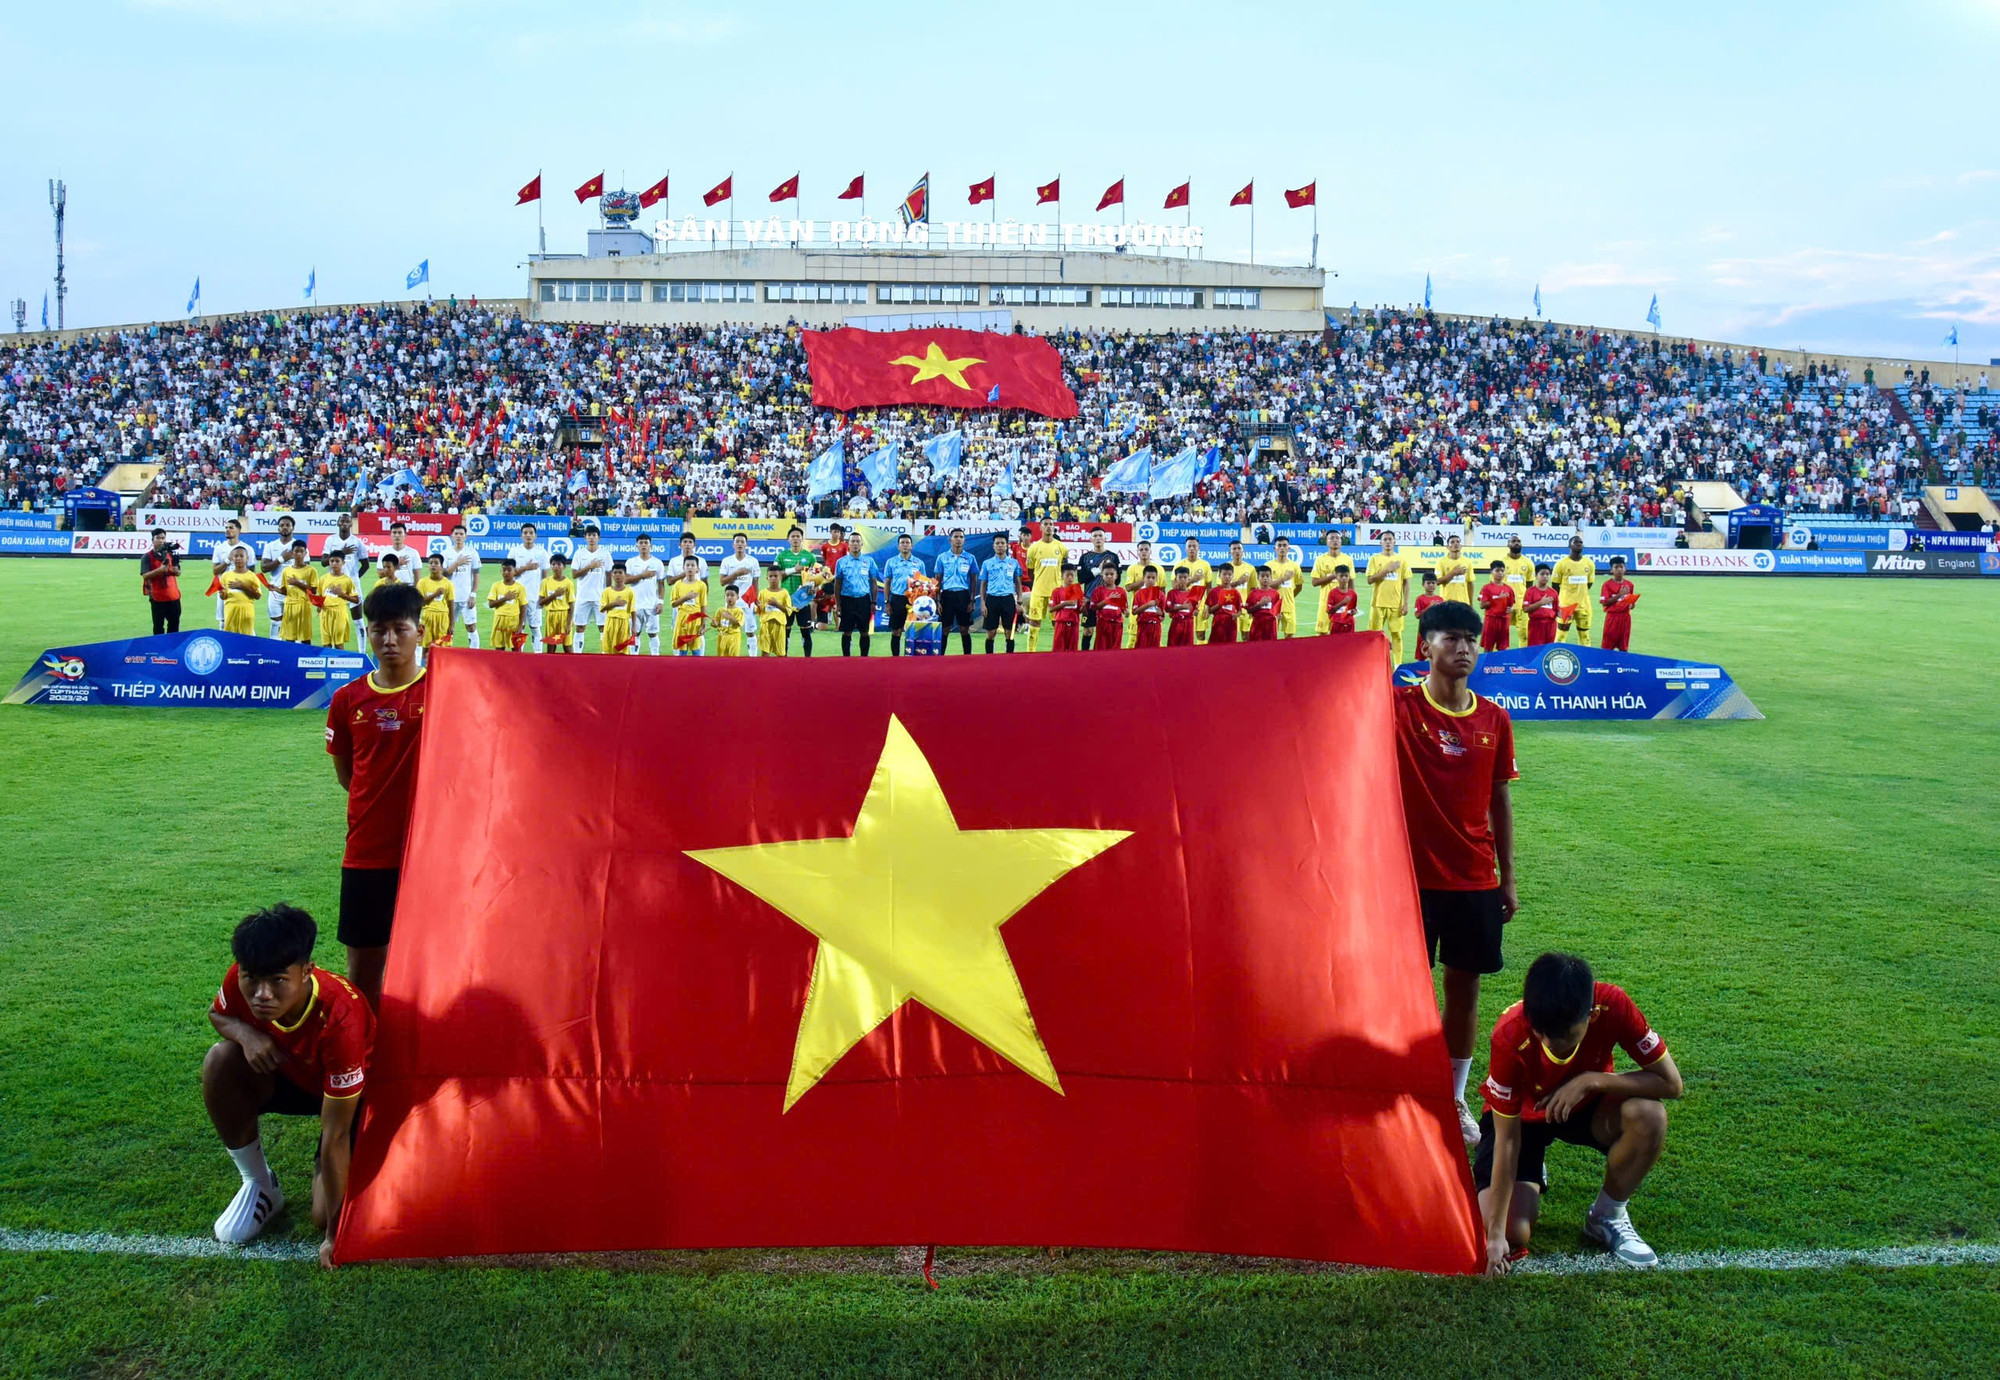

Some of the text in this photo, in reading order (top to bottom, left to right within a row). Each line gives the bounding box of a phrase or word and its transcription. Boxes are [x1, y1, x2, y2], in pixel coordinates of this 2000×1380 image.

[654, 214, 1203, 249] SÂN VẬN ĐỘNG THIÊN TRƯỜNG
[1260, 438, 1269, 446] B2
[1946, 490, 1956, 498] B4
[307, 518, 338, 527] THAC
[493, 521, 506, 531] TẬP
[547, 521, 568, 532] THIỆN
[603, 521, 620, 531] THÉP
[641, 522, 660, 532] XUÂN
[661, 523, 680, 534] THIỆN
[747, 523, 775, 531] BANK
[1162, 527, 1238, 538] THÉP XANH XUÂN THIỆN
[1277, 528, 1296, 538] XUÂN
[1297, 528, 1317, 539] THIỆN
[24, 536, 46, 546] XUÂN
[47, 536, 70, 547] THIỆN
[92, 538, 187, 550] AGRIBK
[1828, 534, 1846, 543] ĐOÀN
[1847, 534, 1866, 544] XUÂN
[1867, 535, 1886, 544] THIỆN
[1931, 536, 1948, 545] NPK
[1949, 536, 1970, 546] NINH
[481, 541, 503, 552] THIỆN
[1160, 550, 1175, 560] XT
[1208, 551, 1229, 559] XANH
[1253, 550, 1275, 561] THIỆN
[1755, 554, 1769, 565] XT
[1779, 554, 1862, 567] XUÂN THIỆN NAM ĐỊNH
[1656, 555, 1750, 567] AGRIBANK
[1873, 554, 1976, 570] Mitre England
[111, 680, 290, 702] THÉP XANH NAM ĐỊNH
[1535, 692, 1546, 709] Á
[1550, 696, 1606, 710] THANH
[1611, 692, 1647, 710] HÓA
